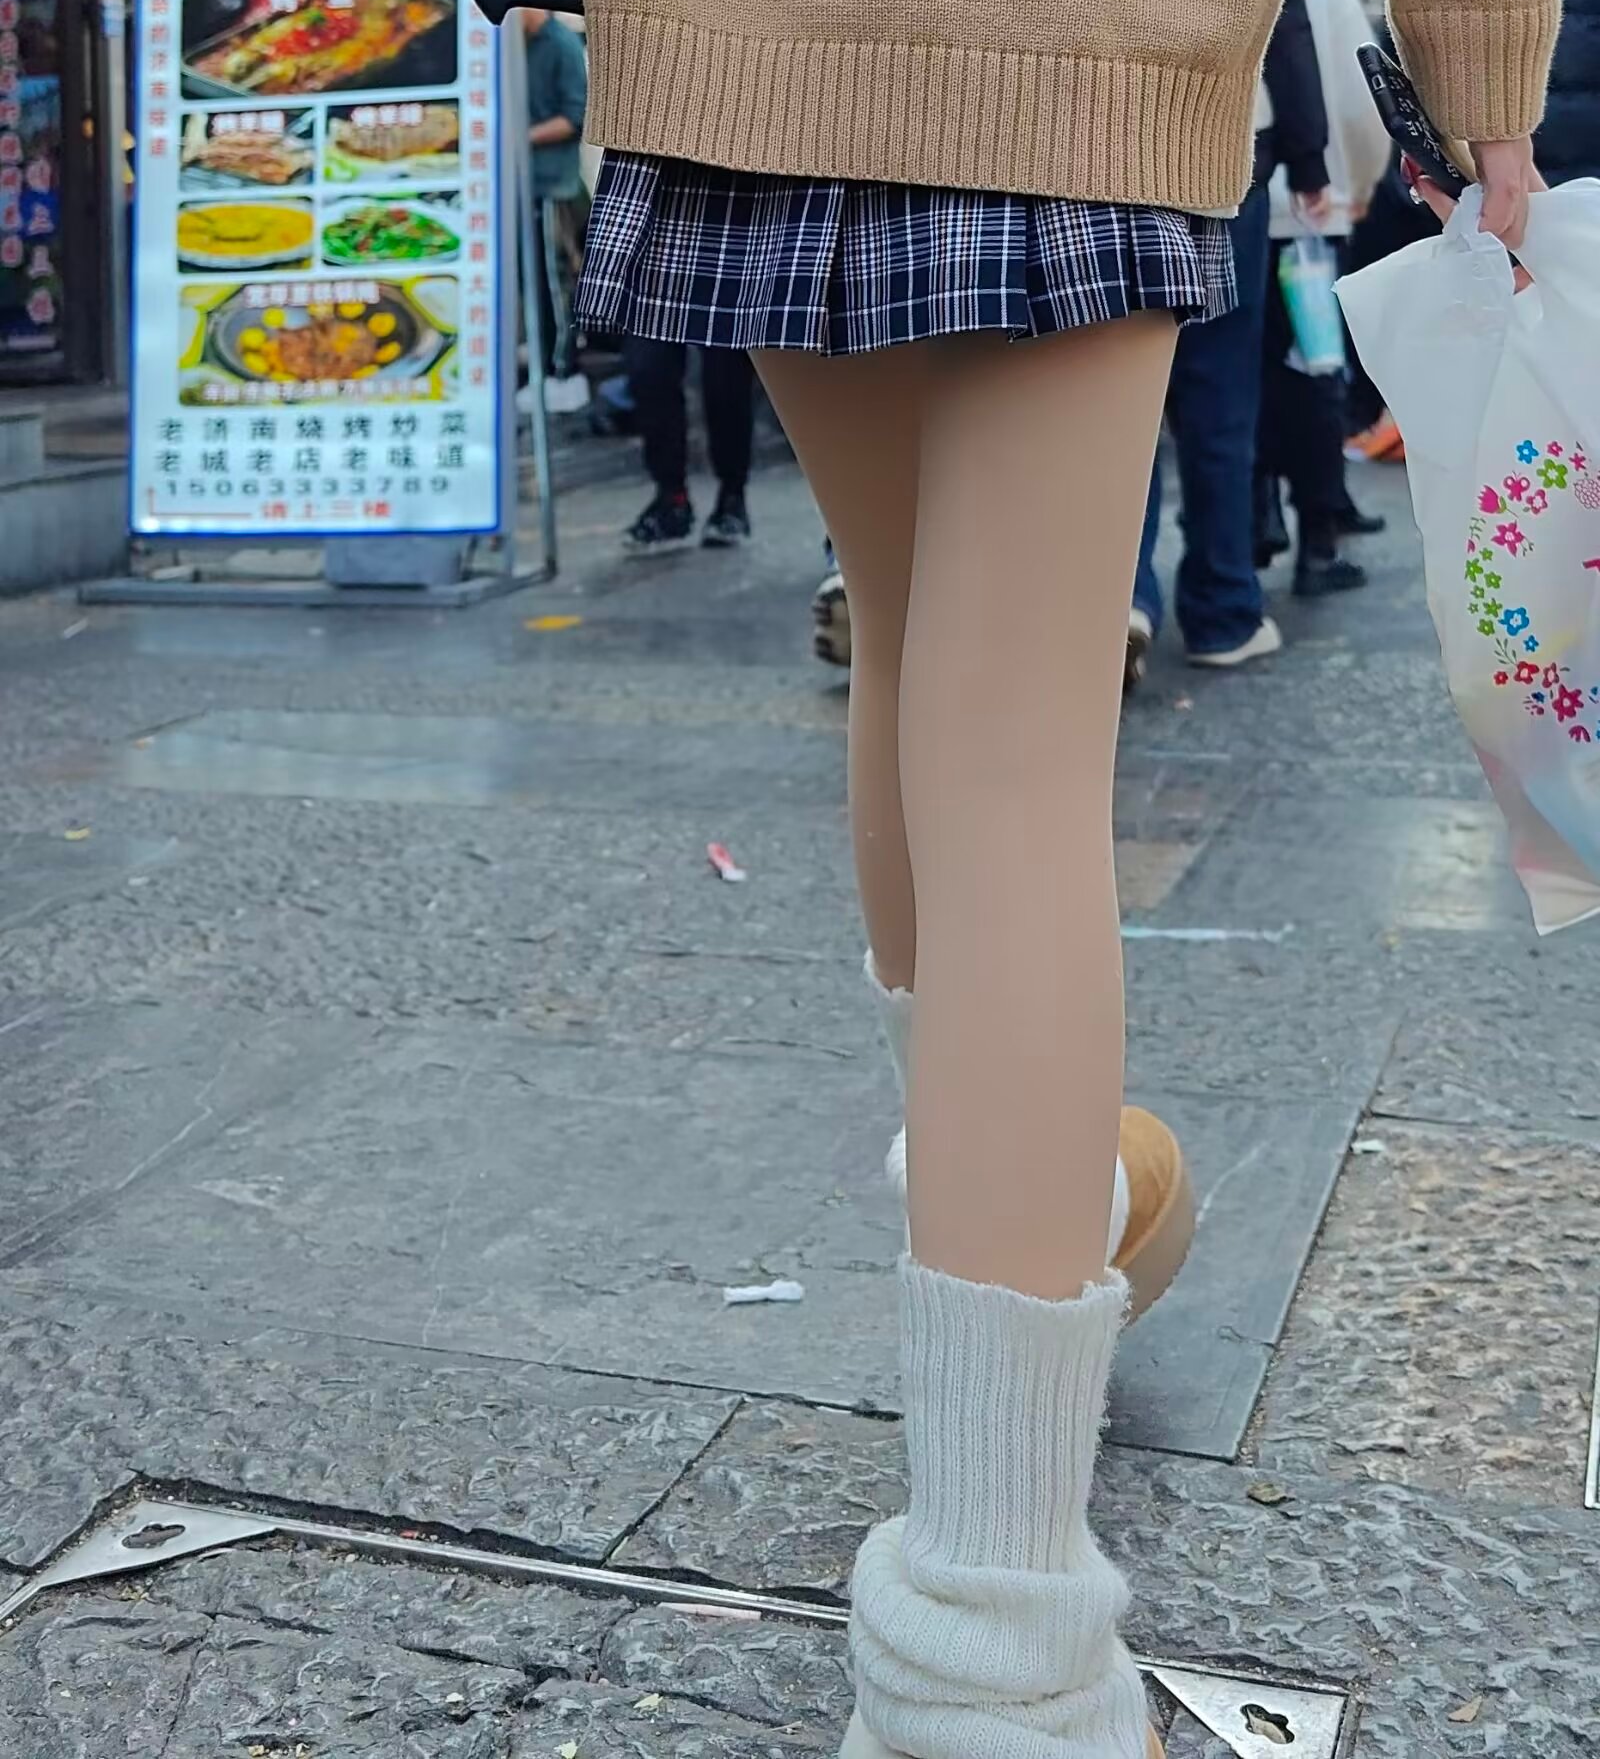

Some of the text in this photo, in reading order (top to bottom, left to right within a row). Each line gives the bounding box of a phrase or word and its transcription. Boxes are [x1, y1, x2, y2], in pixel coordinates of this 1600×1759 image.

[160, 410, 468, 441] 老济南烧烤炒菜
[155, 443, 466, 473] 老城老店老味道
